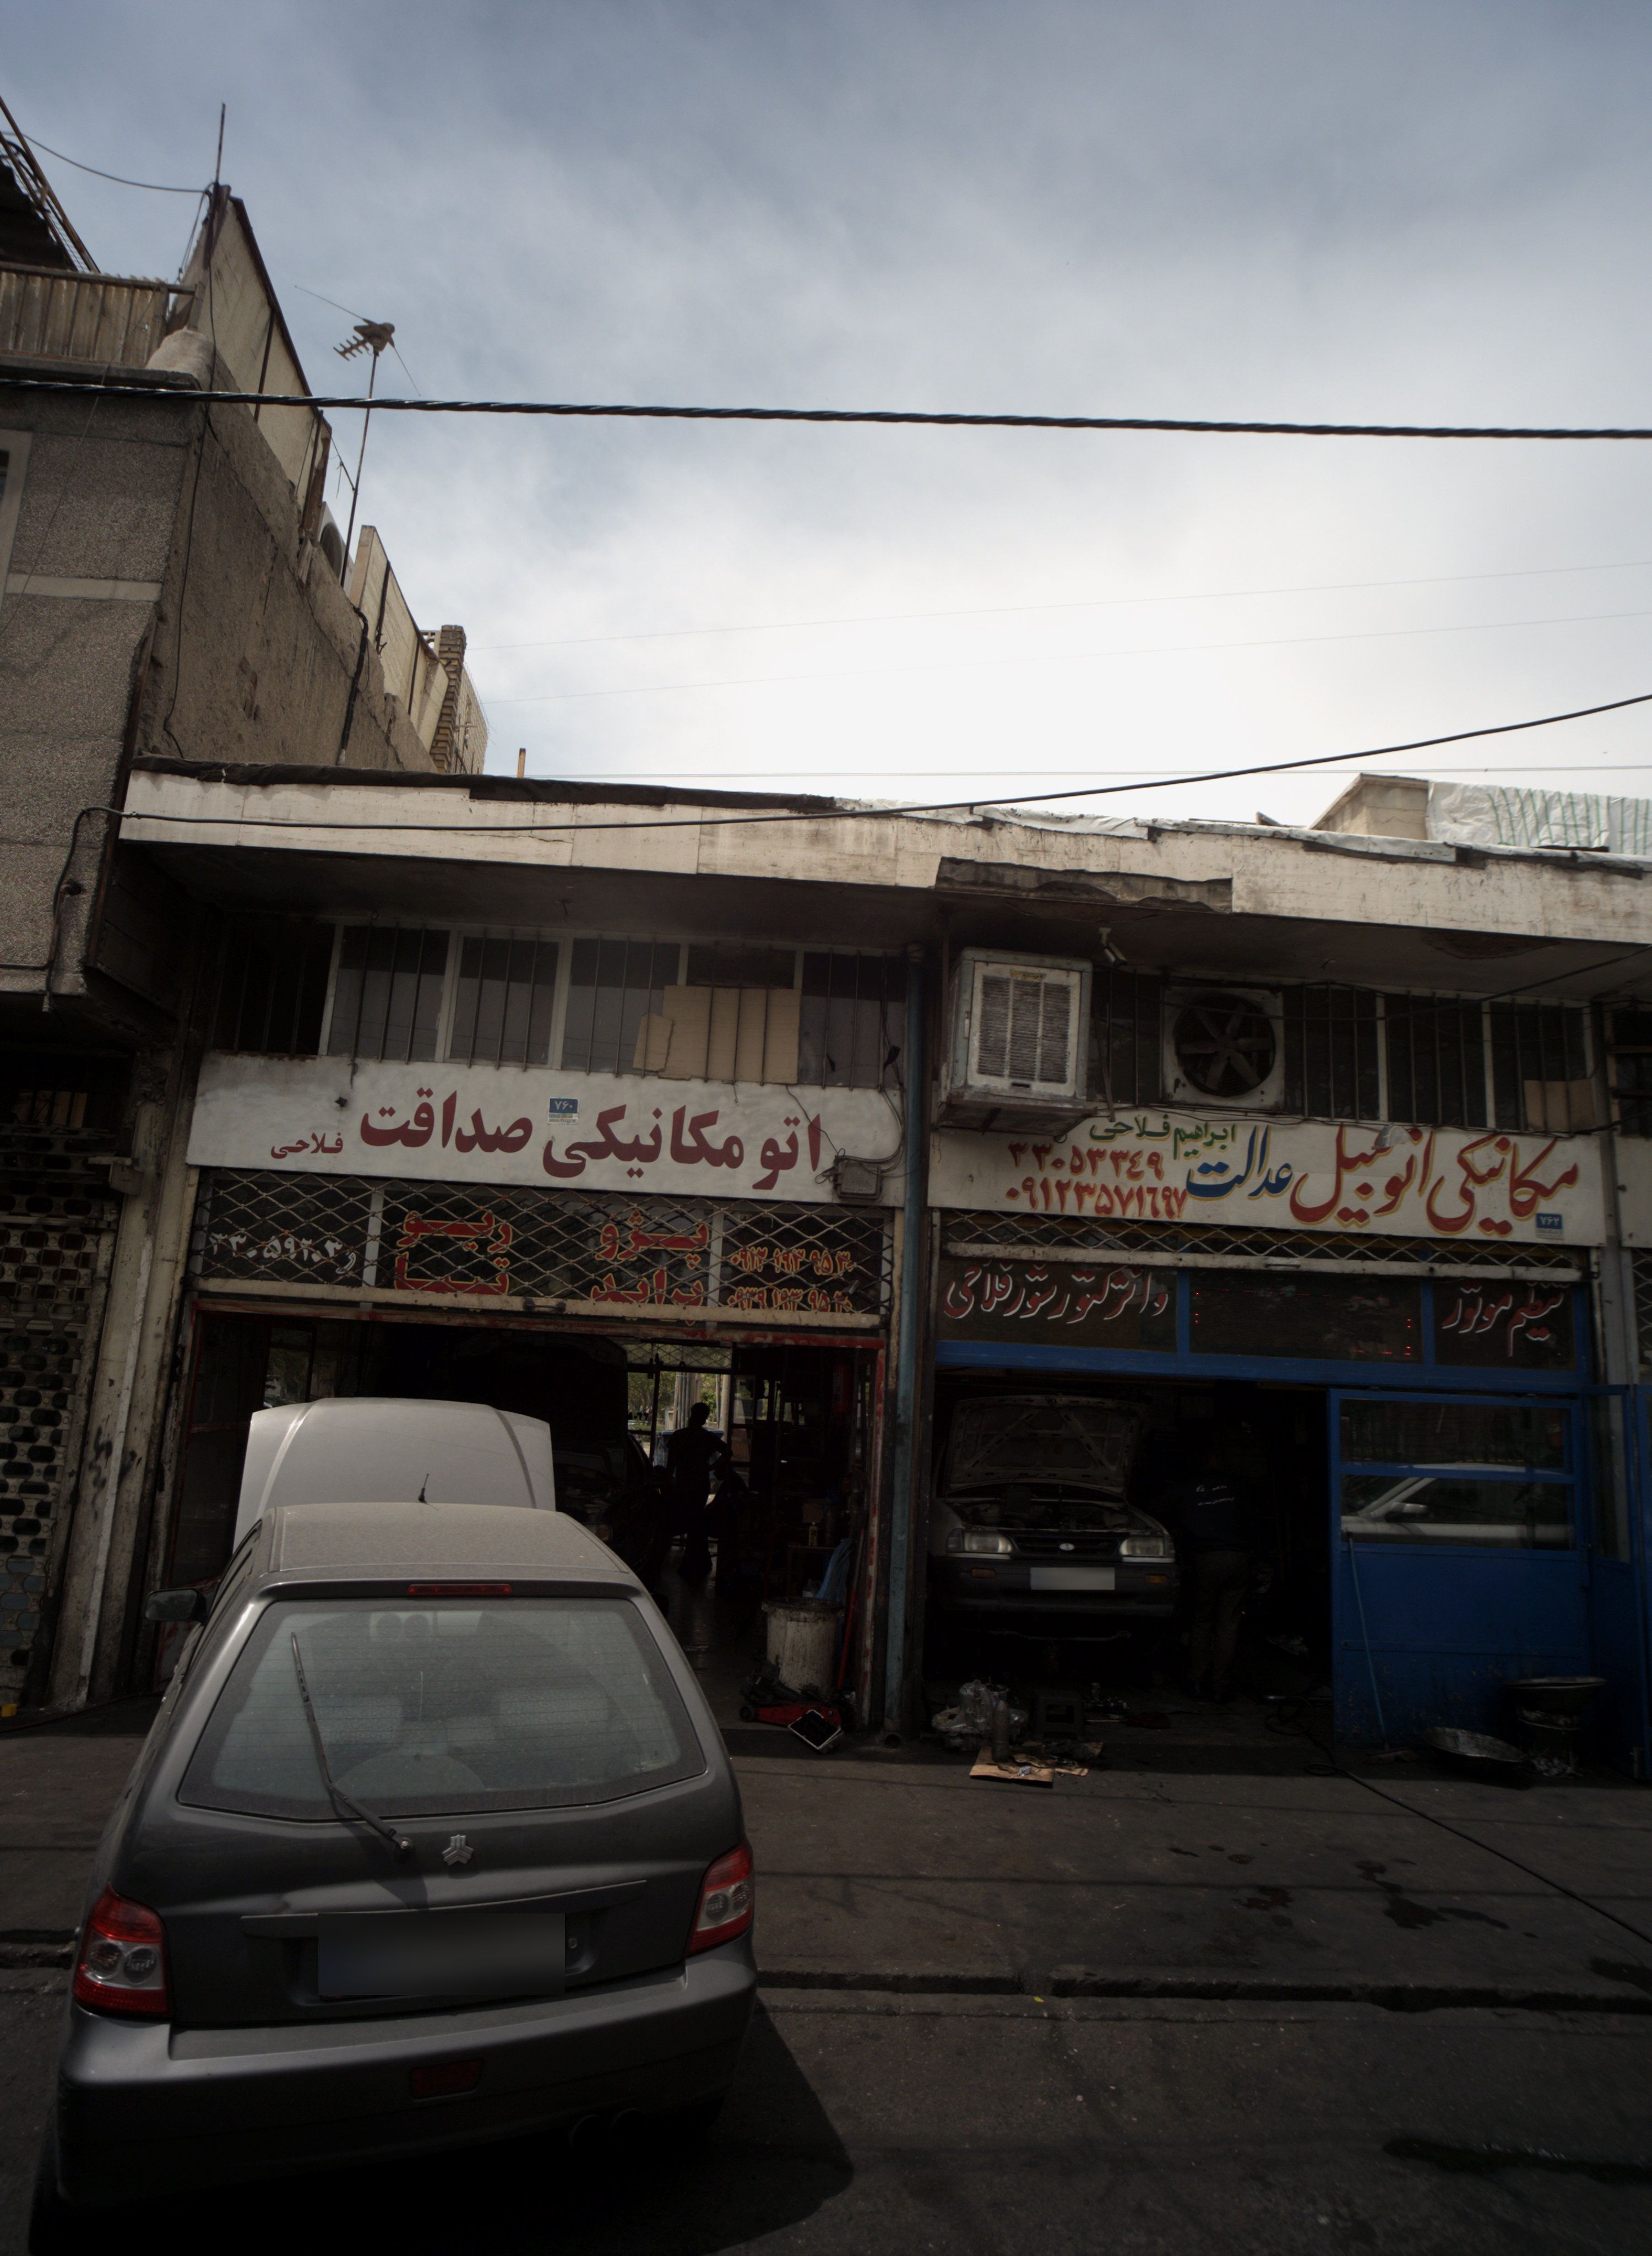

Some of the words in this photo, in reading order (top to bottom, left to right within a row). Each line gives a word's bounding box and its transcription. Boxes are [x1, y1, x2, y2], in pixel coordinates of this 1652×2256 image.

[270, 1132, 343, 1159] فلاحی
[360, 1087, 532, 1153] صداقت
[1090, 1114, 1170, 1140] فلاحی
[1174, 1121, 1236, 1160] ابراهیم
[1186, 1125, 1294, 1198] عدالت
[1290, 1124, 1435, 1224] اتوبیل
[1426, 1132, 1579, 1234] مکانیکی
[396, 1210, 513, 1254] ریو
[595, 1209, 710, 1270] پژو
